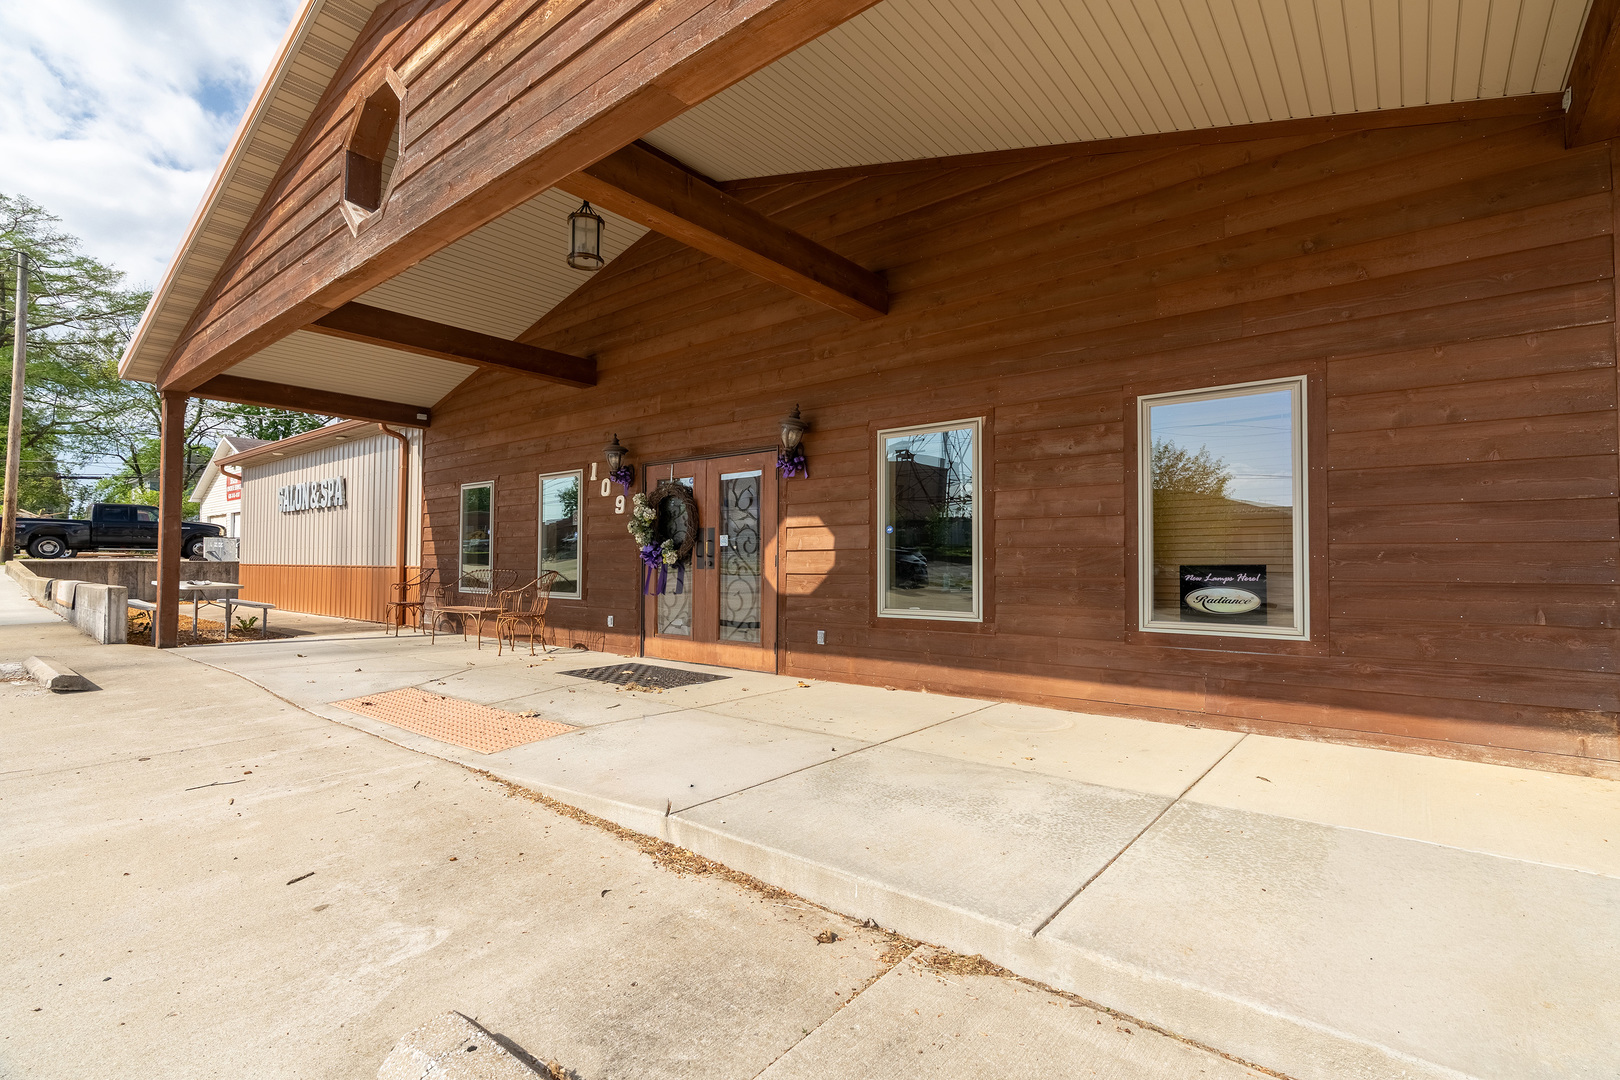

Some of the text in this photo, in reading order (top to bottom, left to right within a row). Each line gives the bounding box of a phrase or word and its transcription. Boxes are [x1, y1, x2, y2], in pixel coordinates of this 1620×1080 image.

[278, 482, 310, 513] SALON
[319, 476, 344, 508] SPA
[590, 462, 625, 514] 109
[1204, 573, 1234, 584] Lamps
[1237, 573, 1261, 582] Here!
[1193, 595, 1252, 611] Radiance
